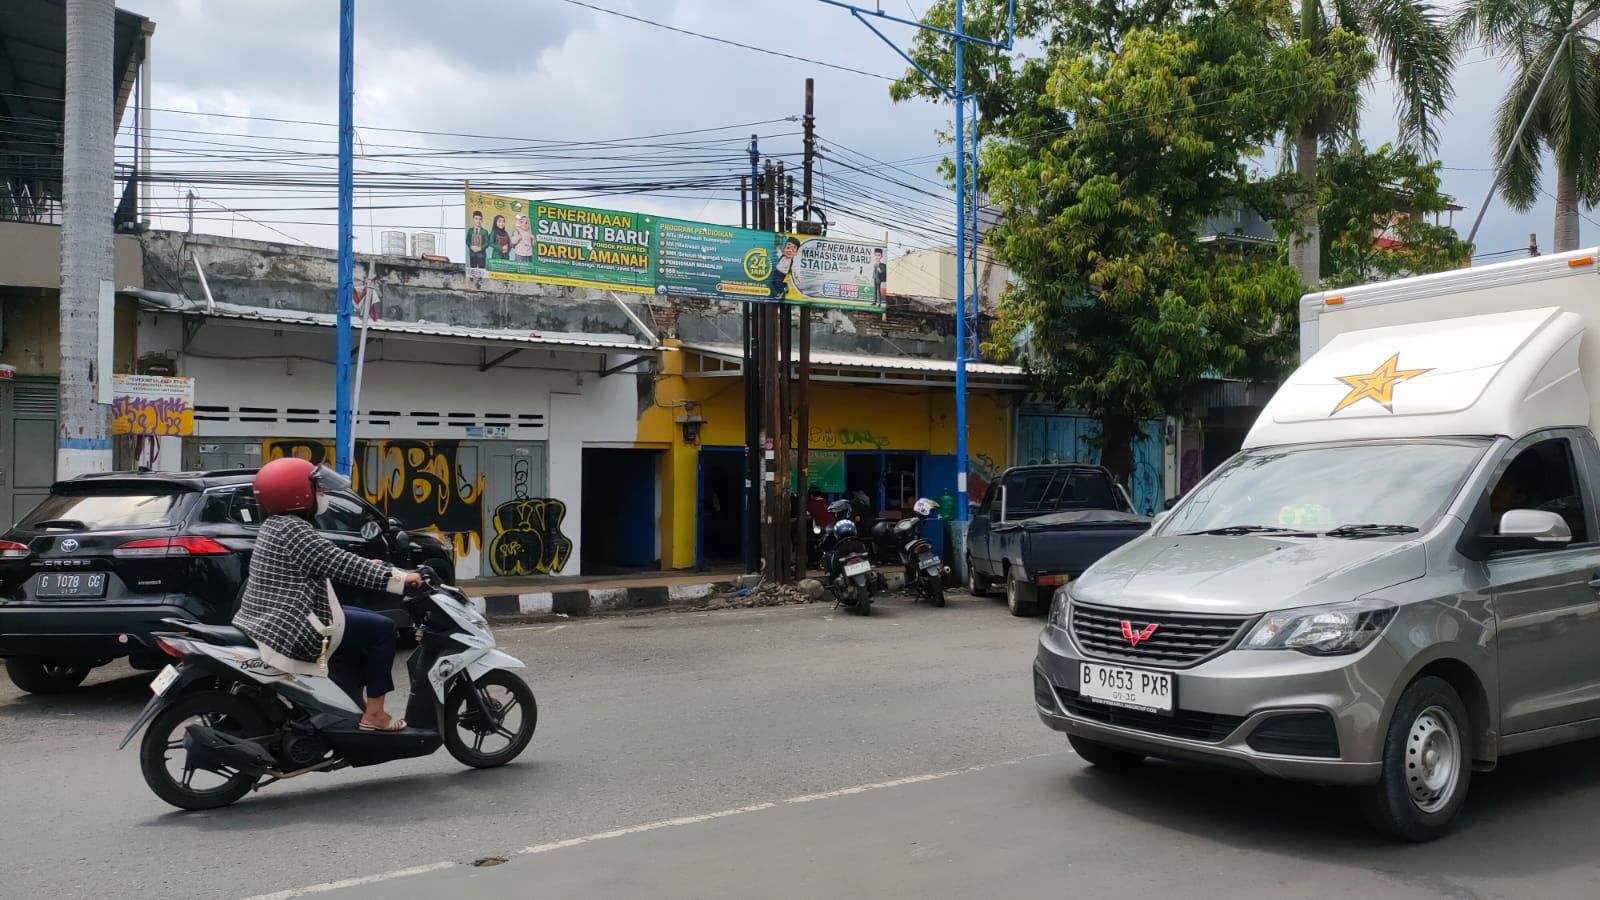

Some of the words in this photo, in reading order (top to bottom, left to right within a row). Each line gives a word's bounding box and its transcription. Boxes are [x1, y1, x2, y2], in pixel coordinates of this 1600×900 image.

[537, 206, 632, 229] PENERIMAAN
[538, 219, 599, 240] SANTRI
[604, 227, 649, 246] BARU
[537, 243, 586, 261] DARUL
[589, 249, 648, 268] AMANAH
[816, 241, 872, 256] PENERIMAAN
[751, 256, 766, 269] 24
[800, 258, 839, 272] STAIDA
[801, 249, 849, 263] MAHASISWA
[850, 254, 872, 265] BARU
[42, 576, 48, 588] G
[57, 575, 80, 588] 1078
[1083, 665, 1091, 684] B
[1099, 668, 1133, 690] 9653
[1141, 674, 1169, 696] PXB
